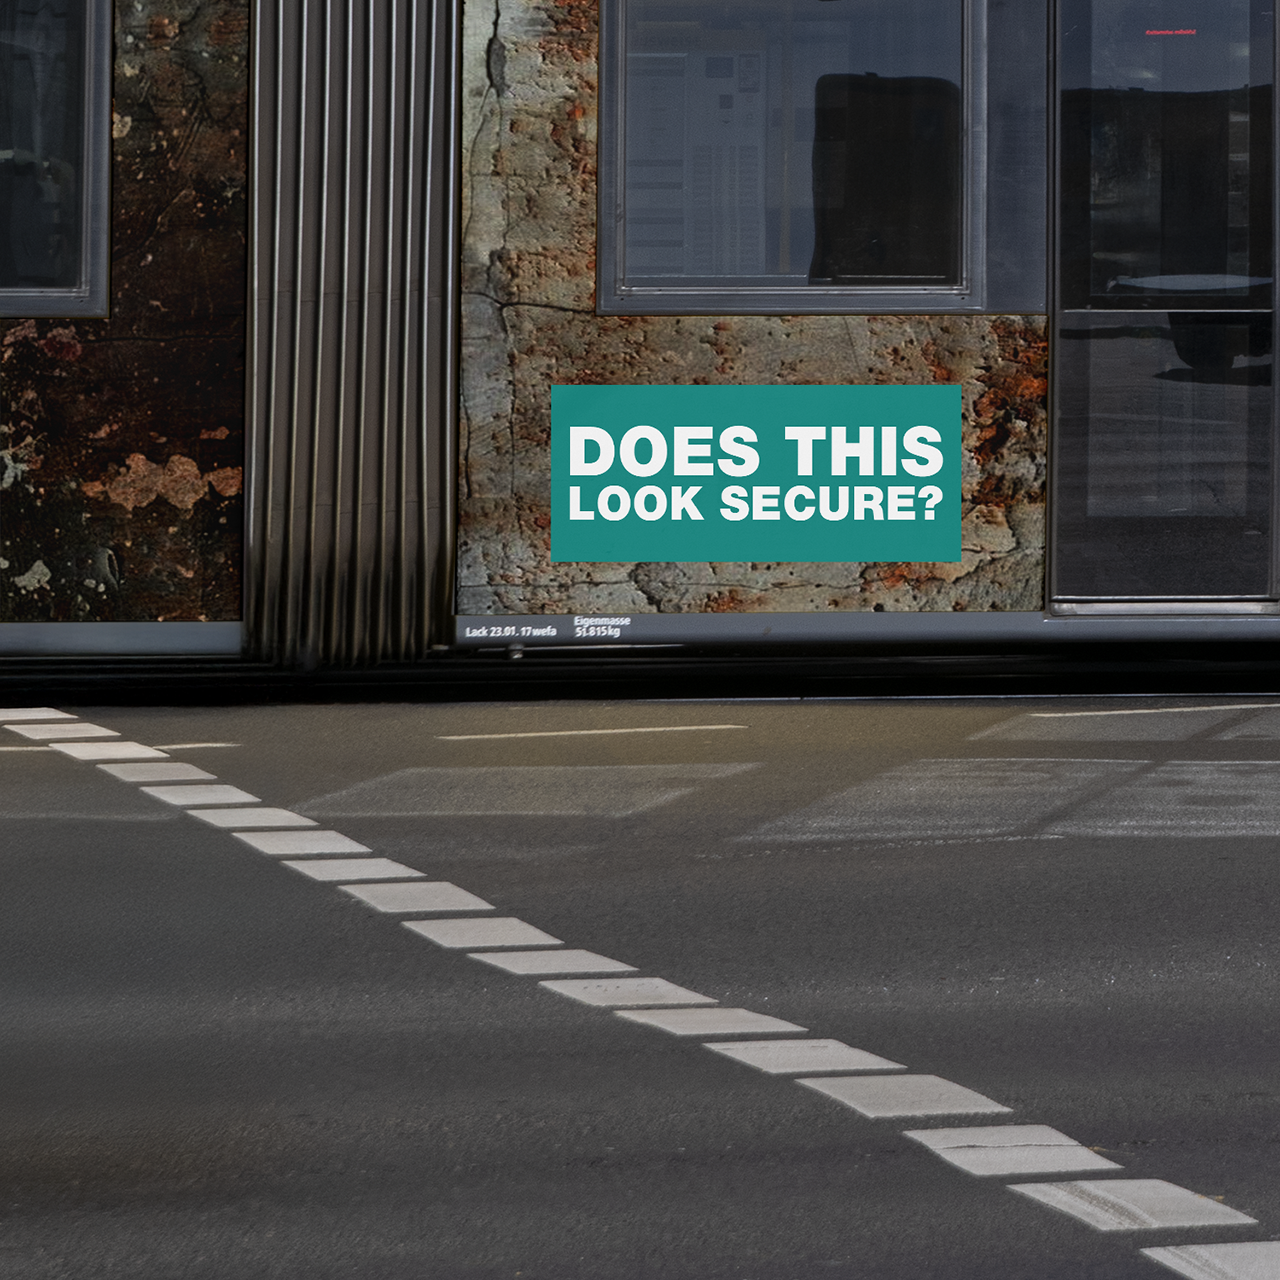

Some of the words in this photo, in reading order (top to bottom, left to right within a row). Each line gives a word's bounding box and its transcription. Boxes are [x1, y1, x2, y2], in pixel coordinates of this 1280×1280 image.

[569, 425, 760, 478] DOES
[784, 425, 944, 478] THIS
[569, 485, 705, 521] LOOK
[719, 485, 943, 521] SECURE?
[465, 626, 488, 637] Lack
[573, 616, 632, 627] Eigenmasse
